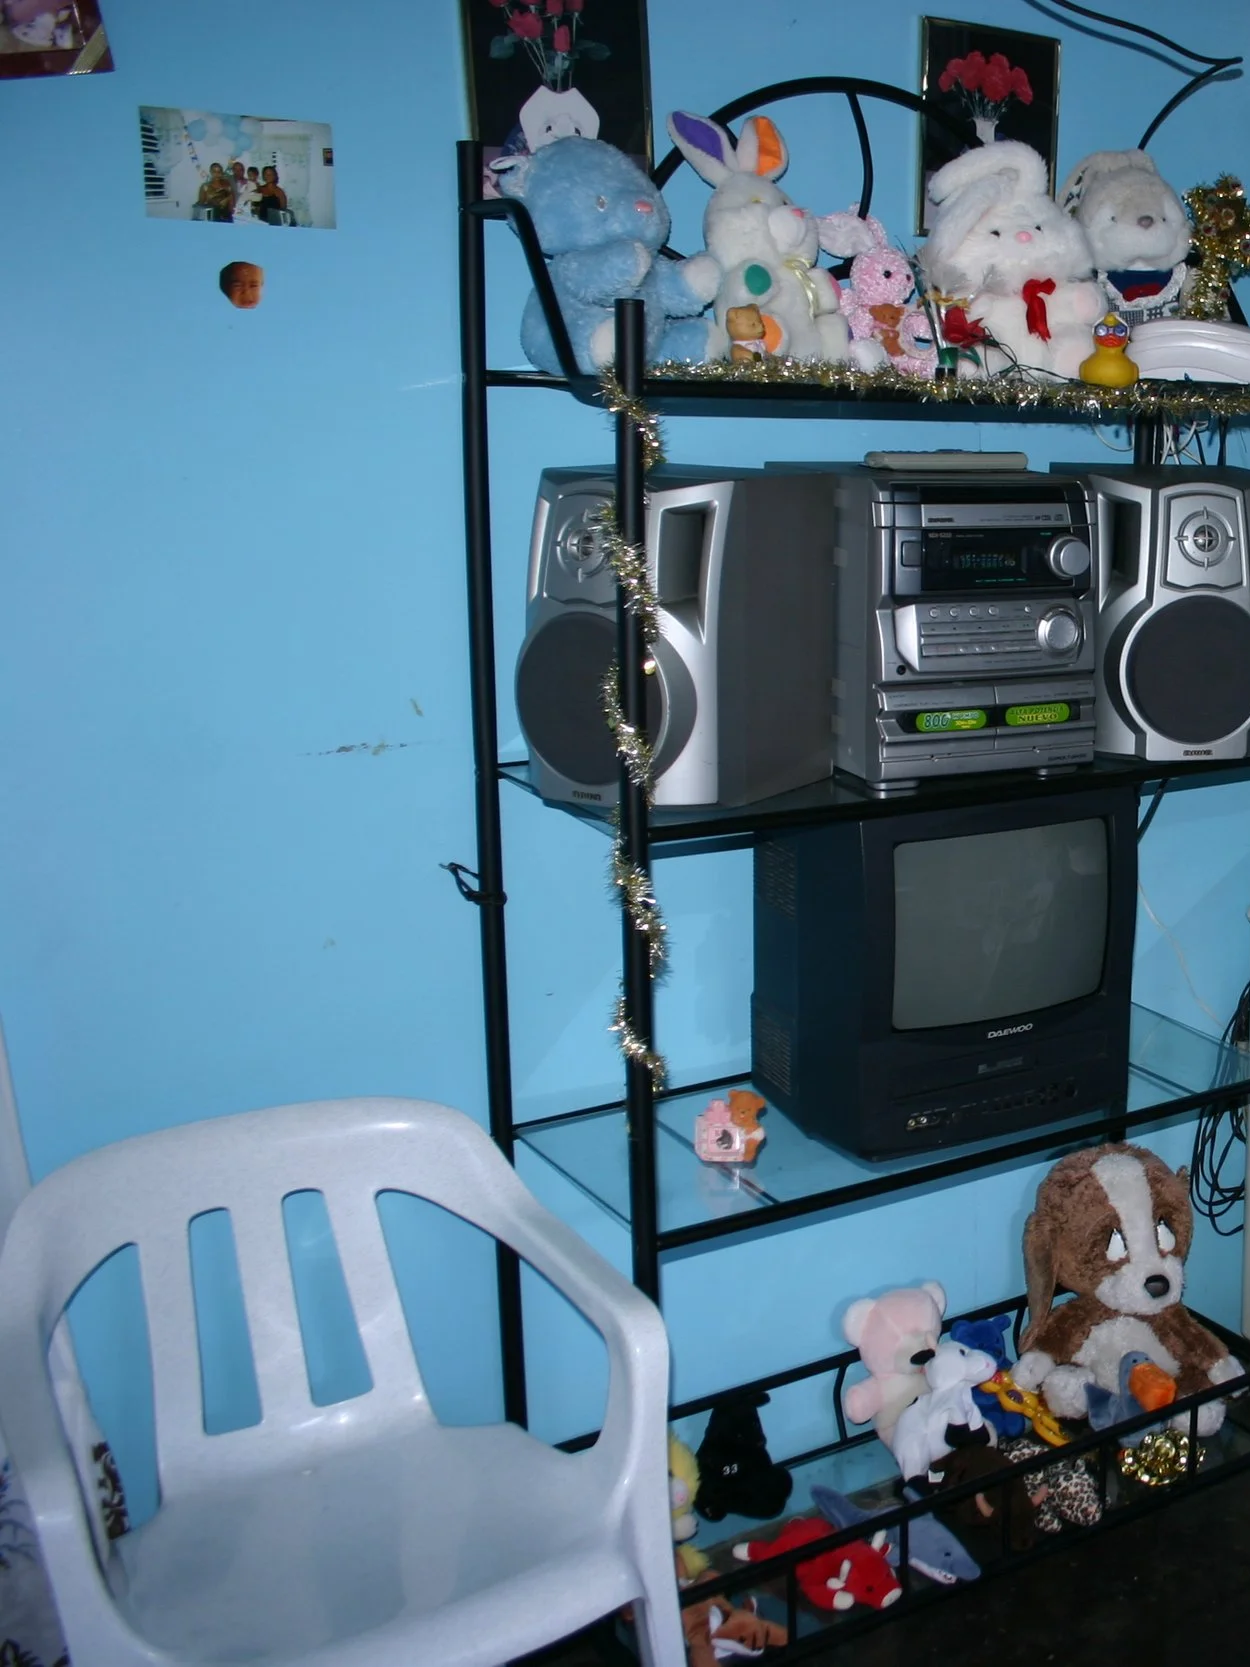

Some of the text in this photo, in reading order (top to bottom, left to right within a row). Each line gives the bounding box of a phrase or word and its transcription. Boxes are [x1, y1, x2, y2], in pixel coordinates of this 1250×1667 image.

[1018, 712, 1058, 724] NUEVO
[987, 1023, 1033, 1039] DAEWOO
[722, 1463, 738, 1476] 33
